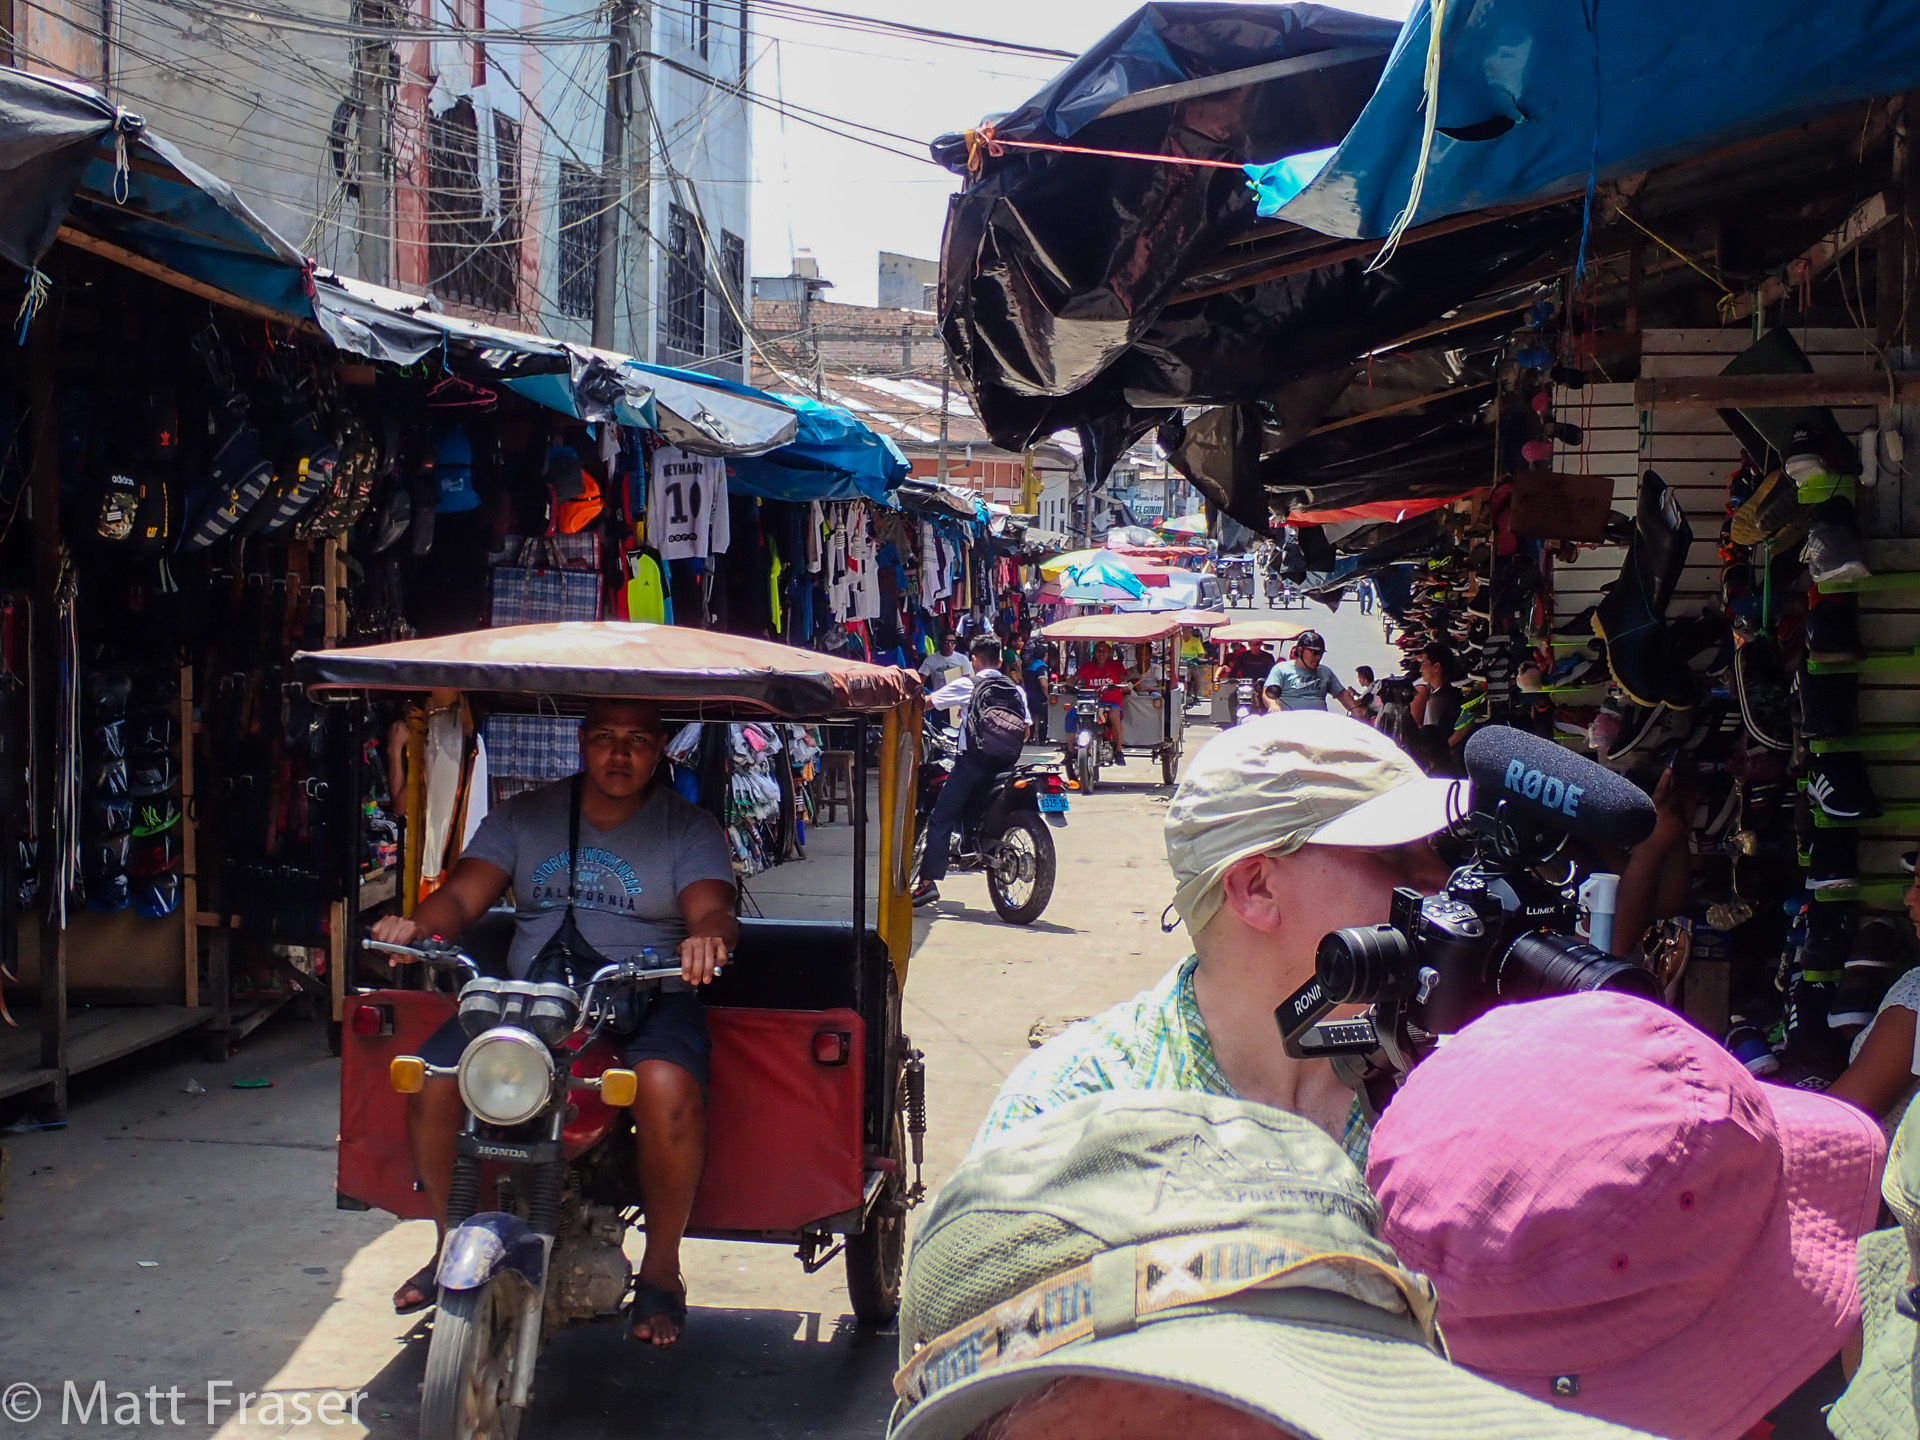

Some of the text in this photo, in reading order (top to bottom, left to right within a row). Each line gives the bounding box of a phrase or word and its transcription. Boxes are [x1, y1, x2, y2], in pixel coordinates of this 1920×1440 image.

[1504, 758, 1585, 818] RØDE
[577, 871, 600, 882] DRY
[584, 847, 622, 868] WORK
[614, 860, 643, 896] WEAR
[532, 886, 636, 912] CALFORNIA
[1526, 906, 1555, 916] LUMIX
[478, 1145, 529, 1158] HONDA
